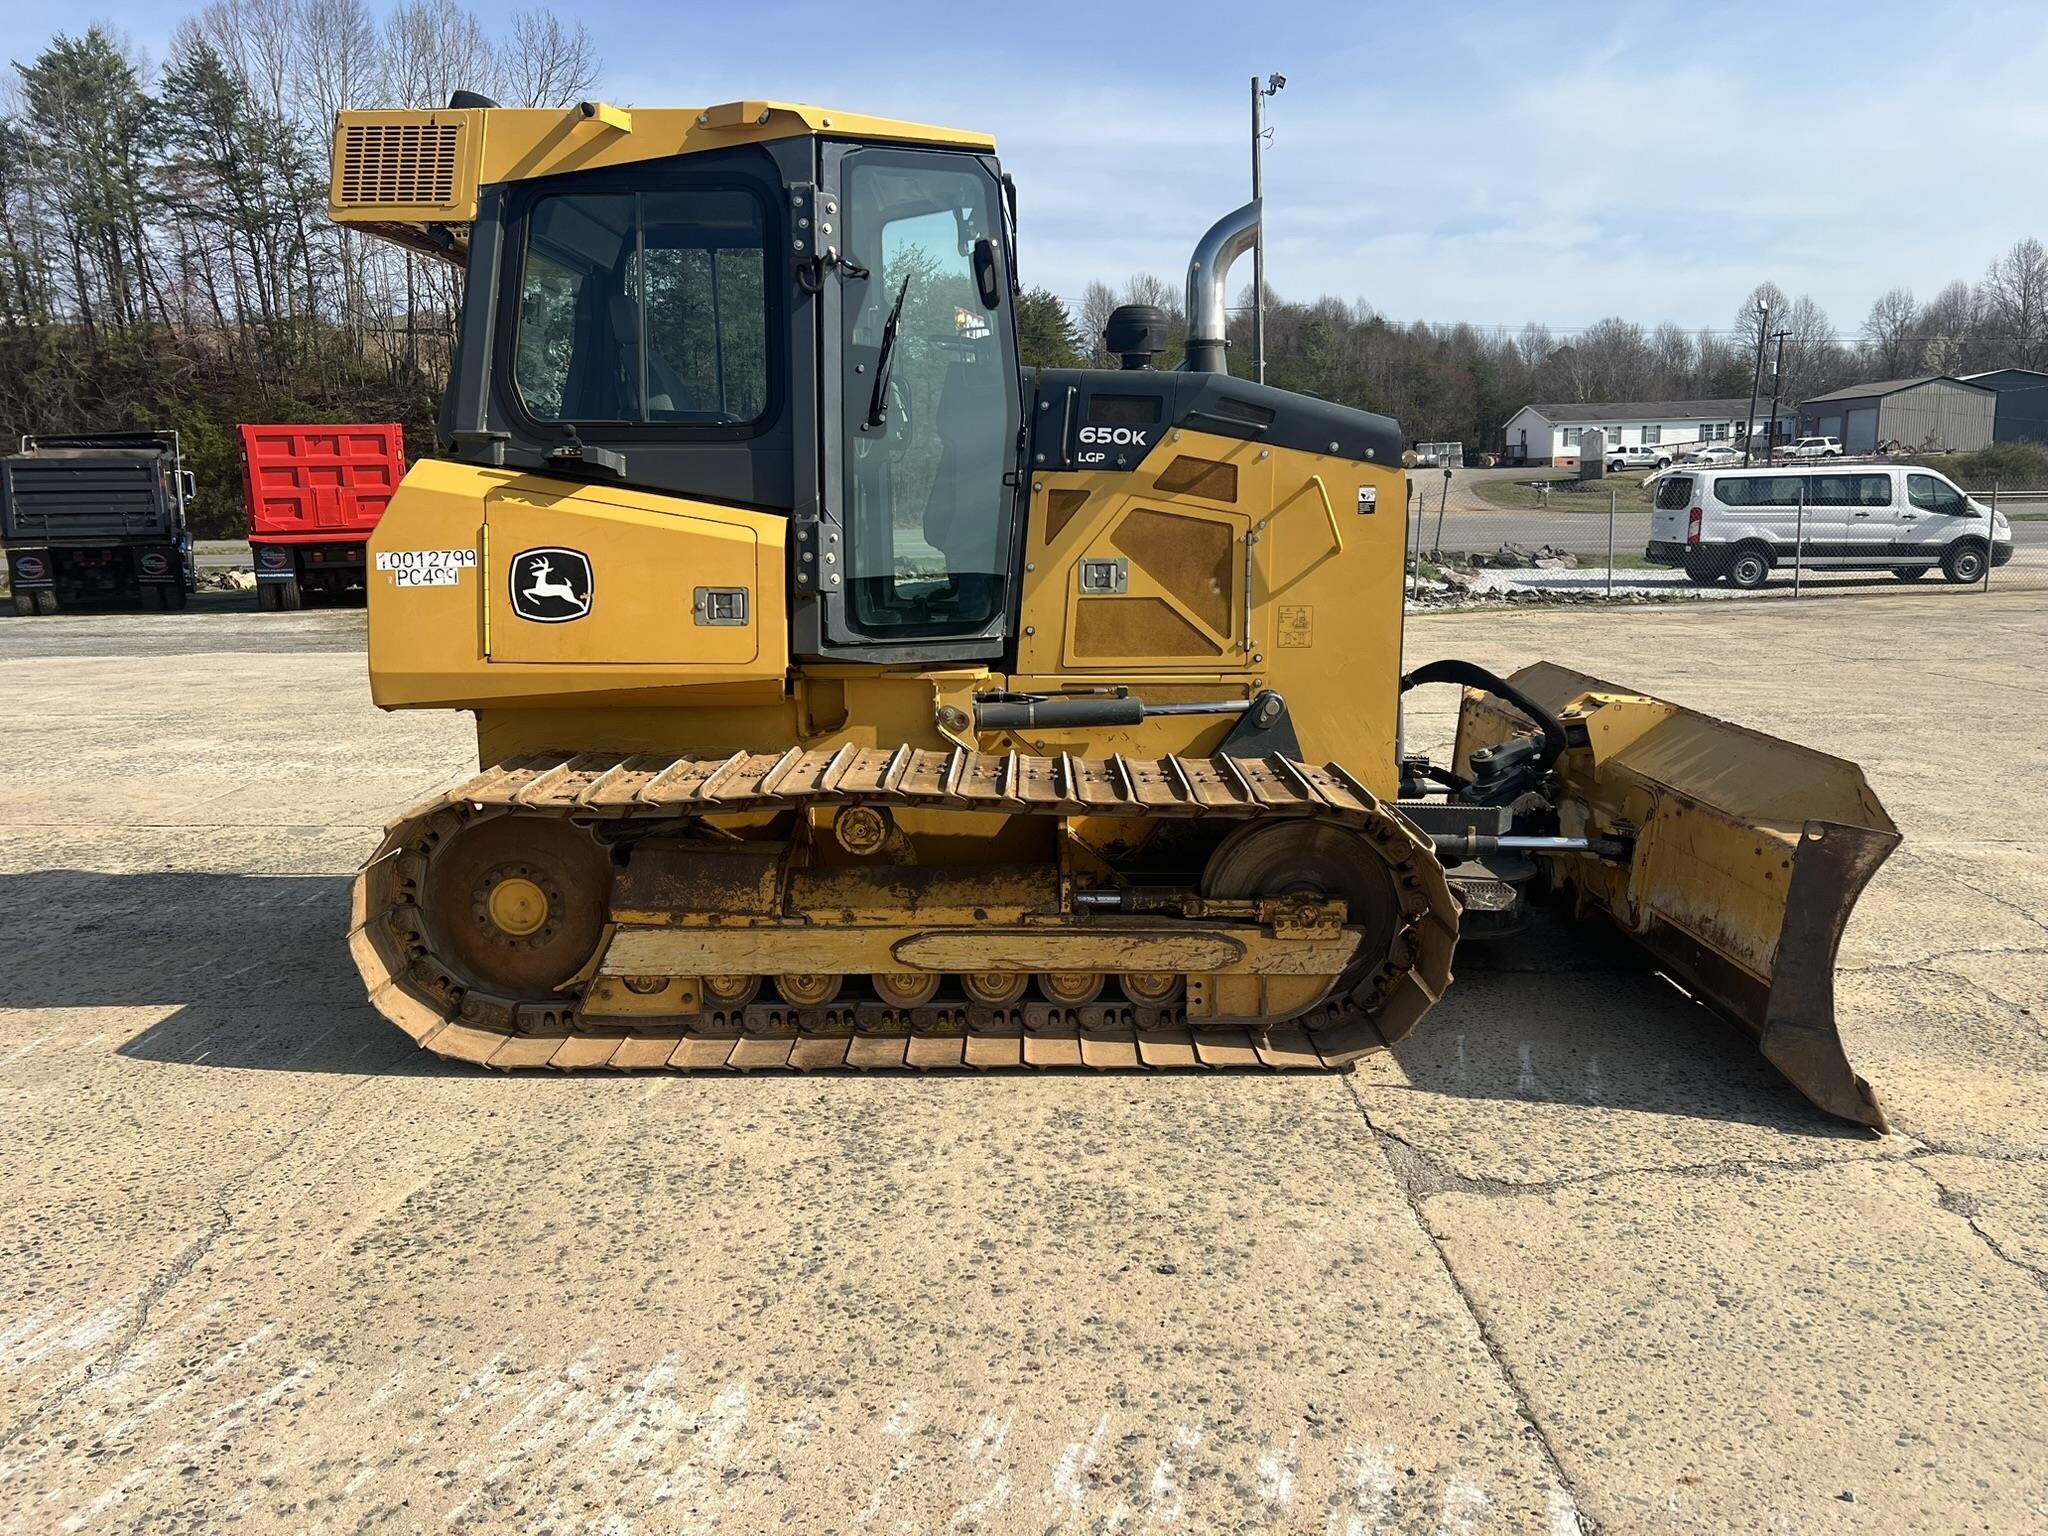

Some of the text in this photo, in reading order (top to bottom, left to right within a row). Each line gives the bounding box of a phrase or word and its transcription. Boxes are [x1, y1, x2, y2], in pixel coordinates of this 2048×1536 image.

[1079, 427, 1147, 446] 650K
[1077, 452, 1106, 463] LGP
[378, 549, 476, 569] 10012799
